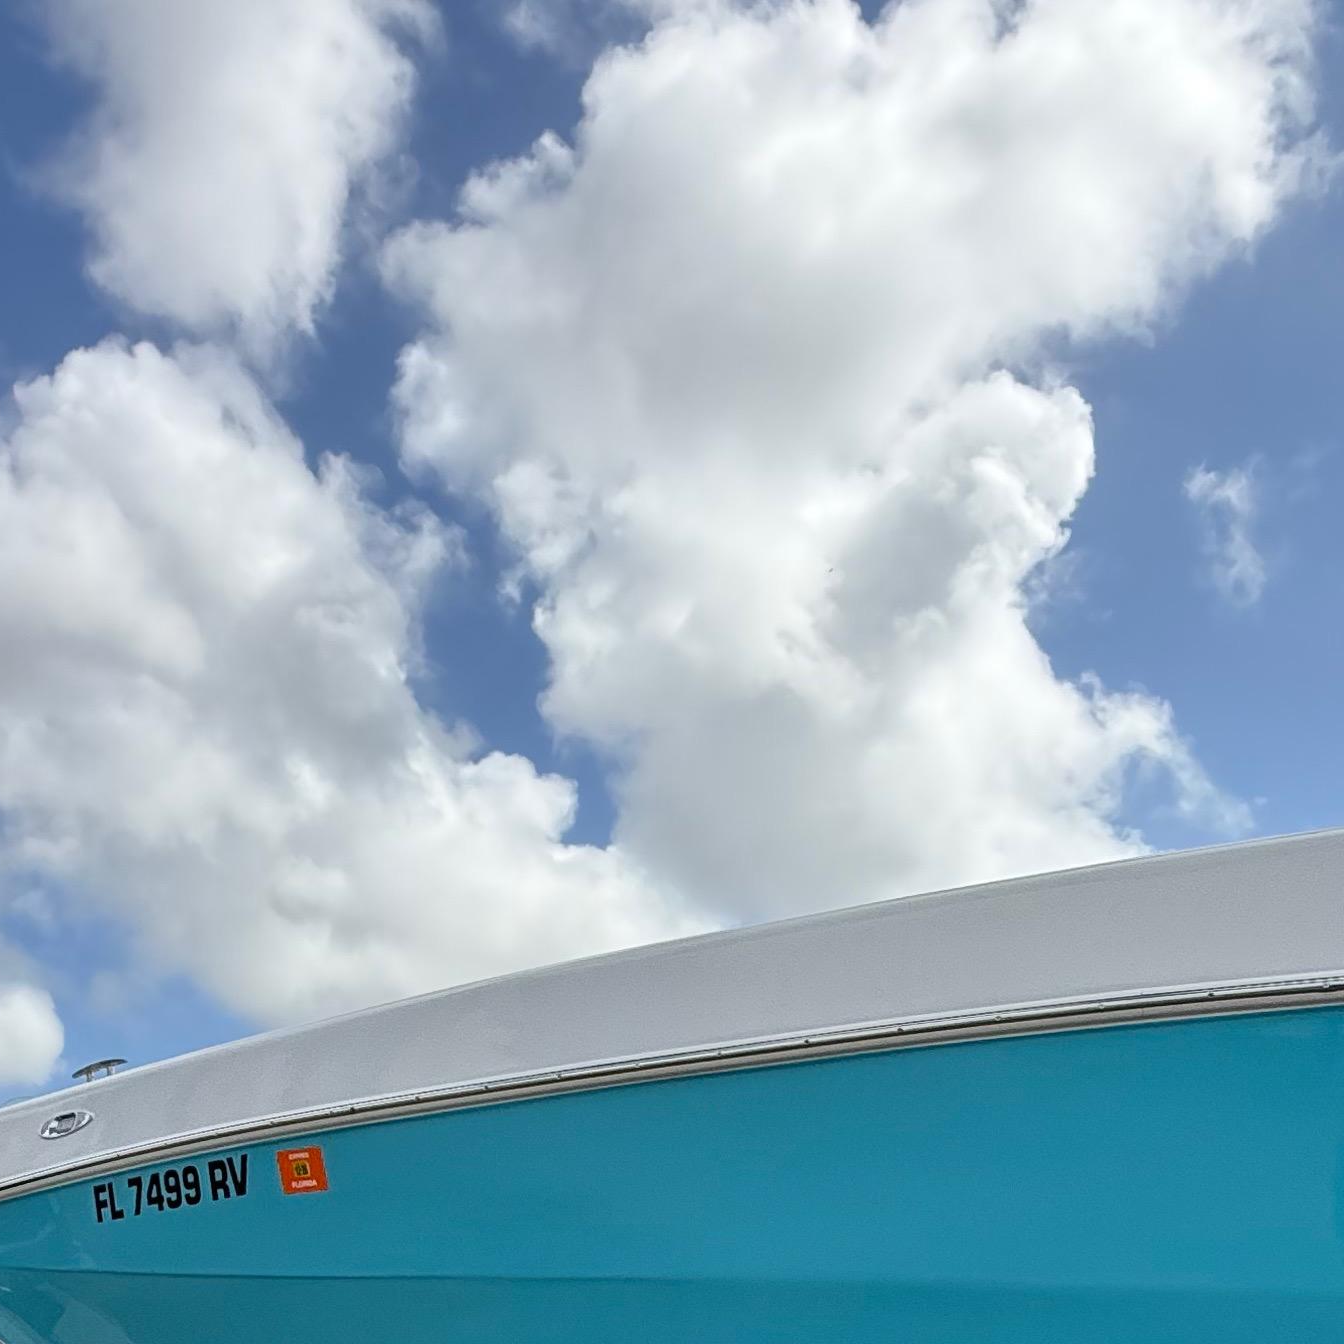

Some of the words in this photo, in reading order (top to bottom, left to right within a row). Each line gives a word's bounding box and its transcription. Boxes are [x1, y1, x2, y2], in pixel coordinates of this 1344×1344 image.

[92, 1182, 125, 1223] FL
[127, 1165, 202, 1216] 7499
[207, 1153, 248, 1201] RV
